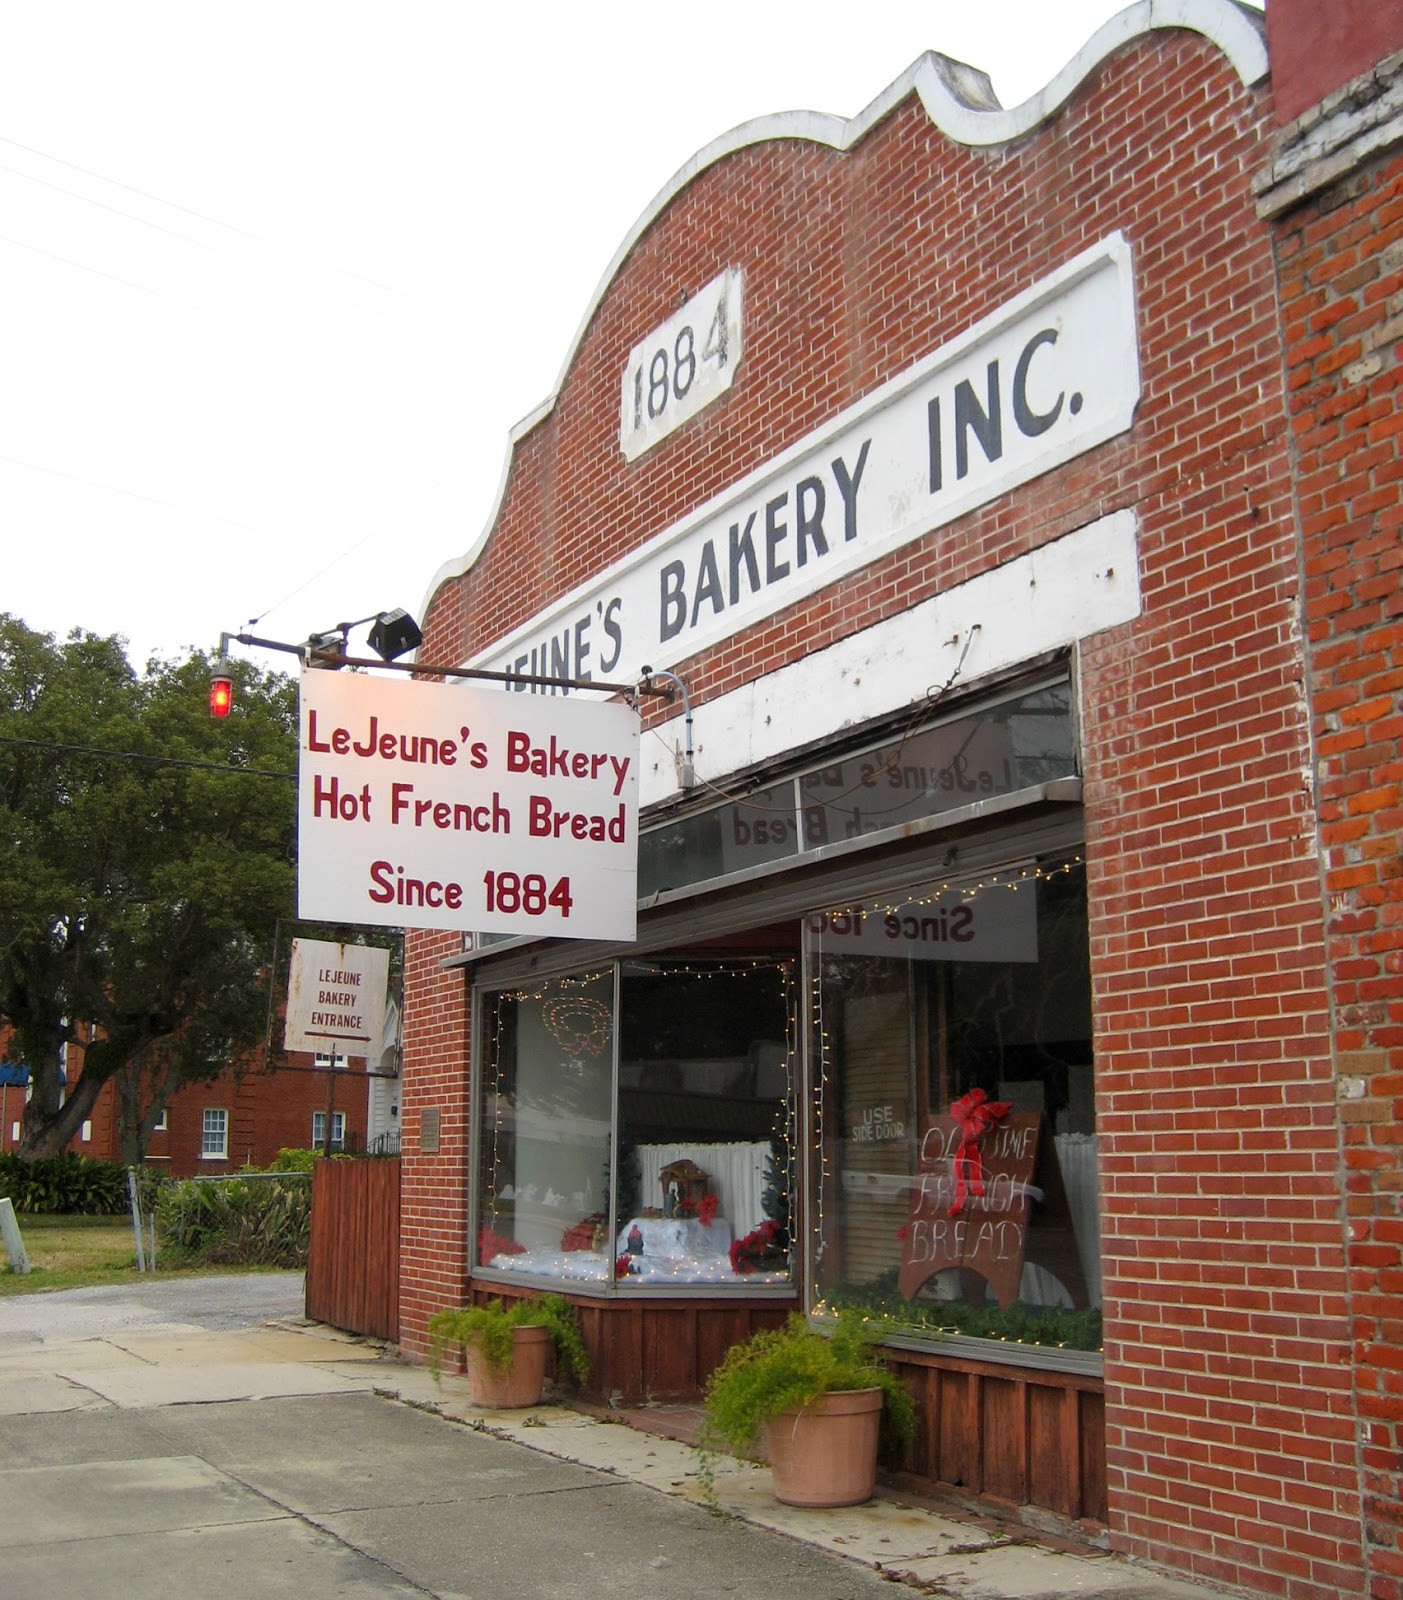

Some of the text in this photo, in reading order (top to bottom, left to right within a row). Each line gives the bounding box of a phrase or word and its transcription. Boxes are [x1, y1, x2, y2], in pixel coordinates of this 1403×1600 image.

[633, 294, 728, 431] 1884
[660, 439, 872, 642] BAKERY
[927, 328, 1083, 494] INC.
[308, 710, 631, 796] LeJeune's Bakery
[314, 775, 626, 844] Hot French Bread
[369, 861, 573, 918] Since 1884
[318, 968, 362, 987] LEJEUNE
[318, 990, 358, 1008] BAKERY
[311, 1011, 363, 1030] ENTRANCE
[853, 1123, 905, 1142] SIDE DOOR
[863, 1107, 893, 1124] USE
[921, 1126, 986, 1164] OL
[914, 1173, 1028, 1215] FRNCH
[908, 1219, 1022, 1265] BREAD
